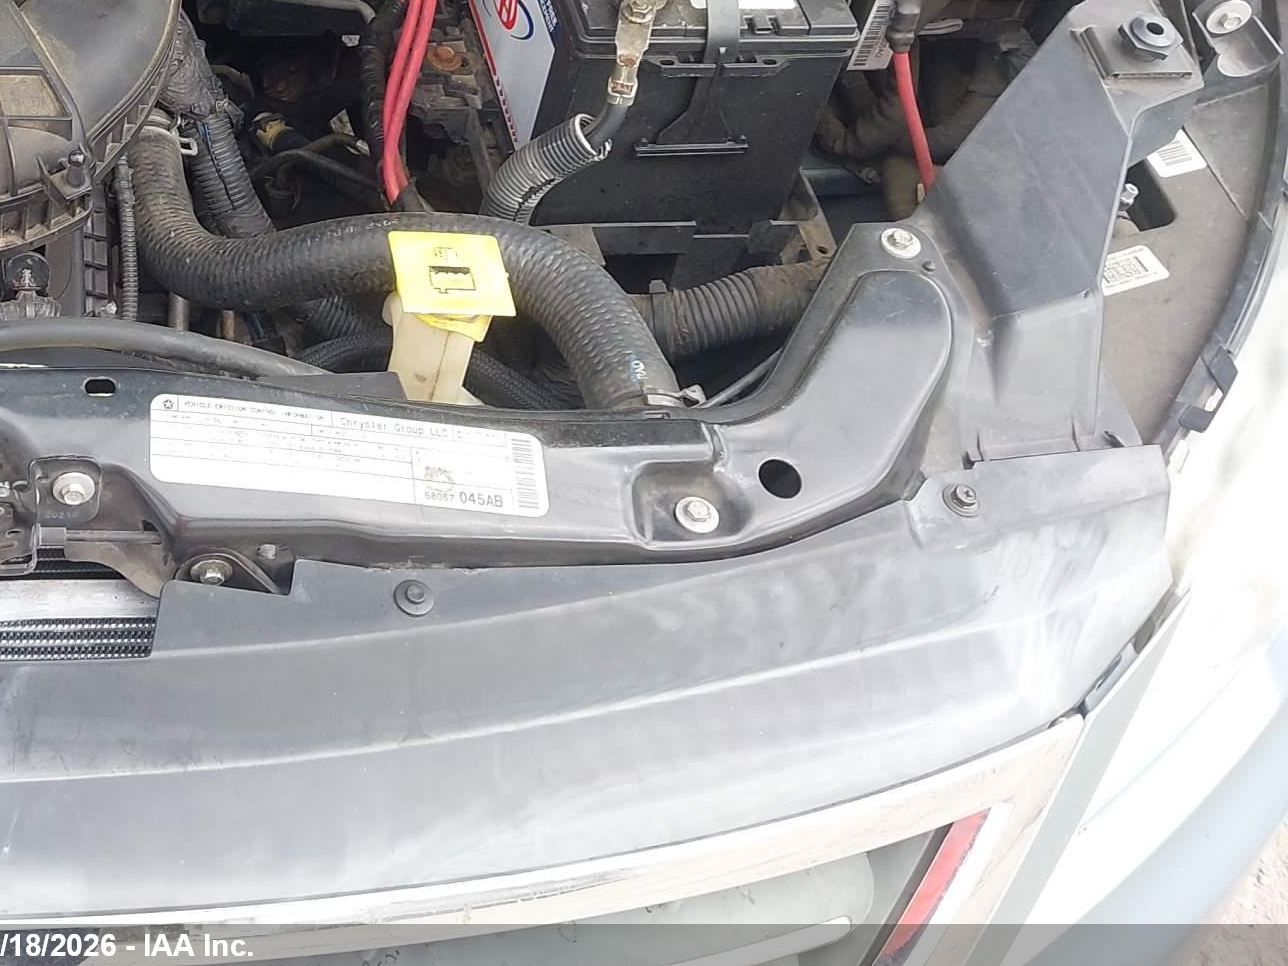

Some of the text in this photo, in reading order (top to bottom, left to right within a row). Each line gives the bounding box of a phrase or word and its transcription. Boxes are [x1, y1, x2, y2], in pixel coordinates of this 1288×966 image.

[545, 1, 558, 28] FREE
[339, 417, 388, 430] Chrysler
[393, 422, 425, 436] Group
[429, 426, 449, 439] LLC
[458, 491, 504, 508] 045AB
